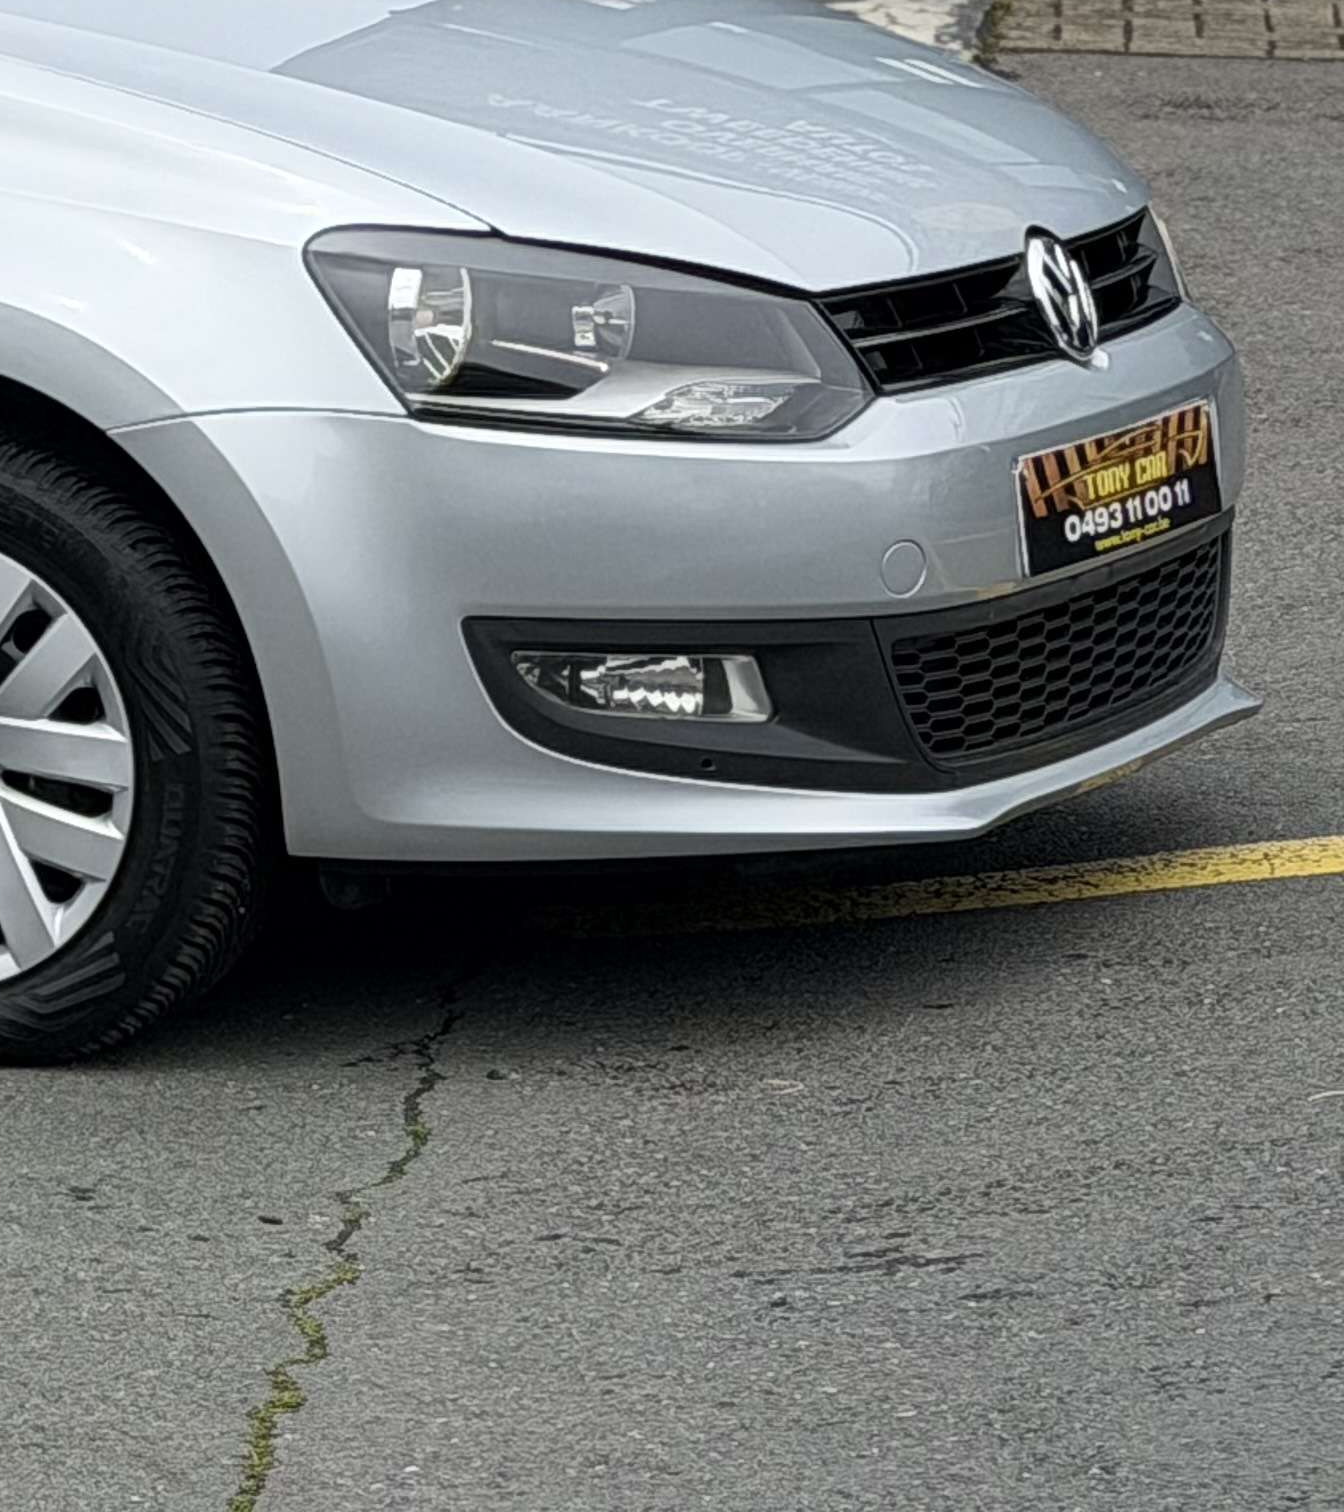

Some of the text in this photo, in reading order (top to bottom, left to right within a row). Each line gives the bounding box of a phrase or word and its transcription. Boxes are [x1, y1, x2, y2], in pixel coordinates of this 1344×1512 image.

[1085, 463, 1132, 500] TONY
[1064, 478, 1192, 543] 0493 11 00 11
